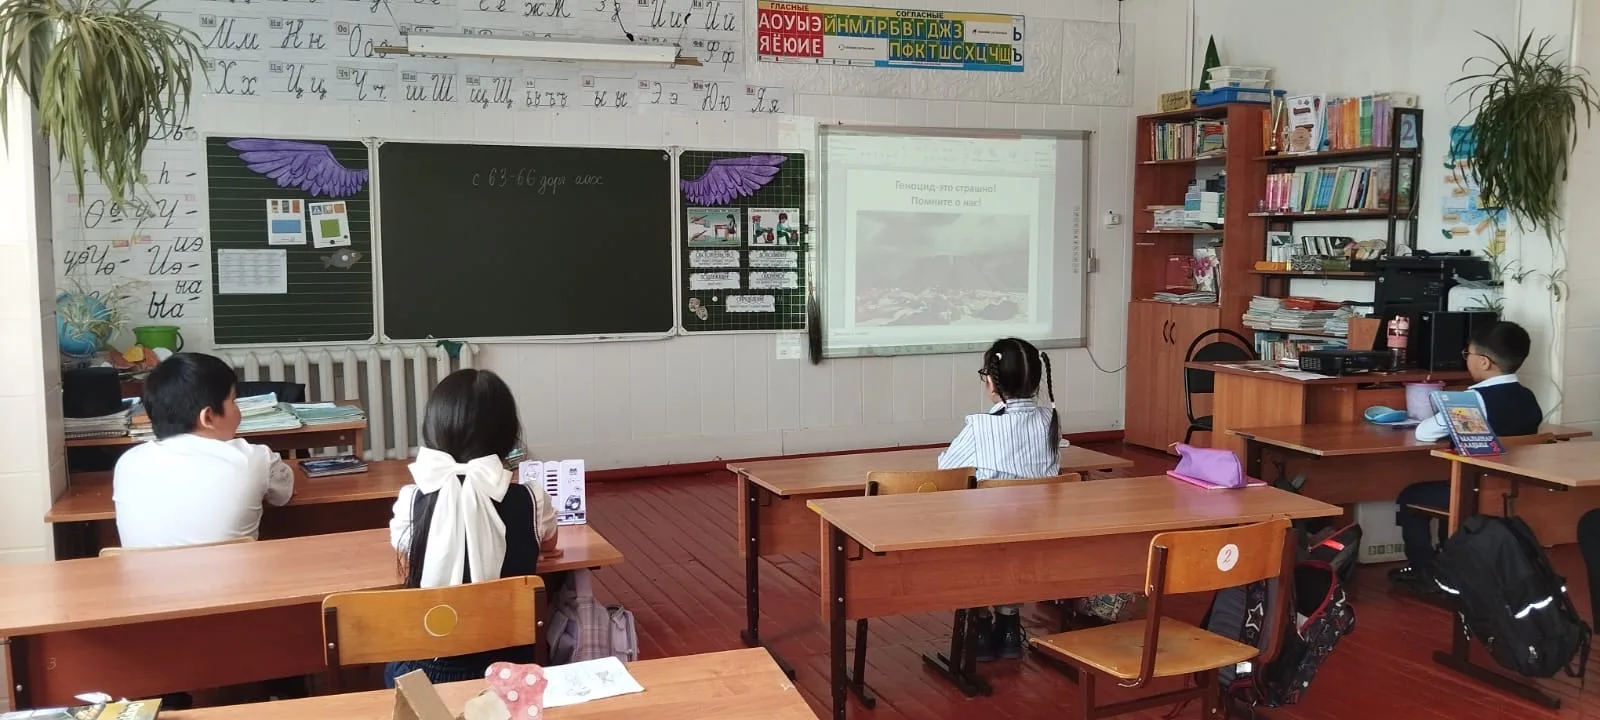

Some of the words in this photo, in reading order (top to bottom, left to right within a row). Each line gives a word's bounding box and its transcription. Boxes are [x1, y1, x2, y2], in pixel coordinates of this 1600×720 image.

[770, 2, 810, 12] ГЛАСНЫЕ
[896, 10, 945, 20] СОГЛАСНЫЕ
[955, 184, 998, 195] страшно!
[911, 196, 953, 208] Помните
[1222, 548, 1233, 565] 2
